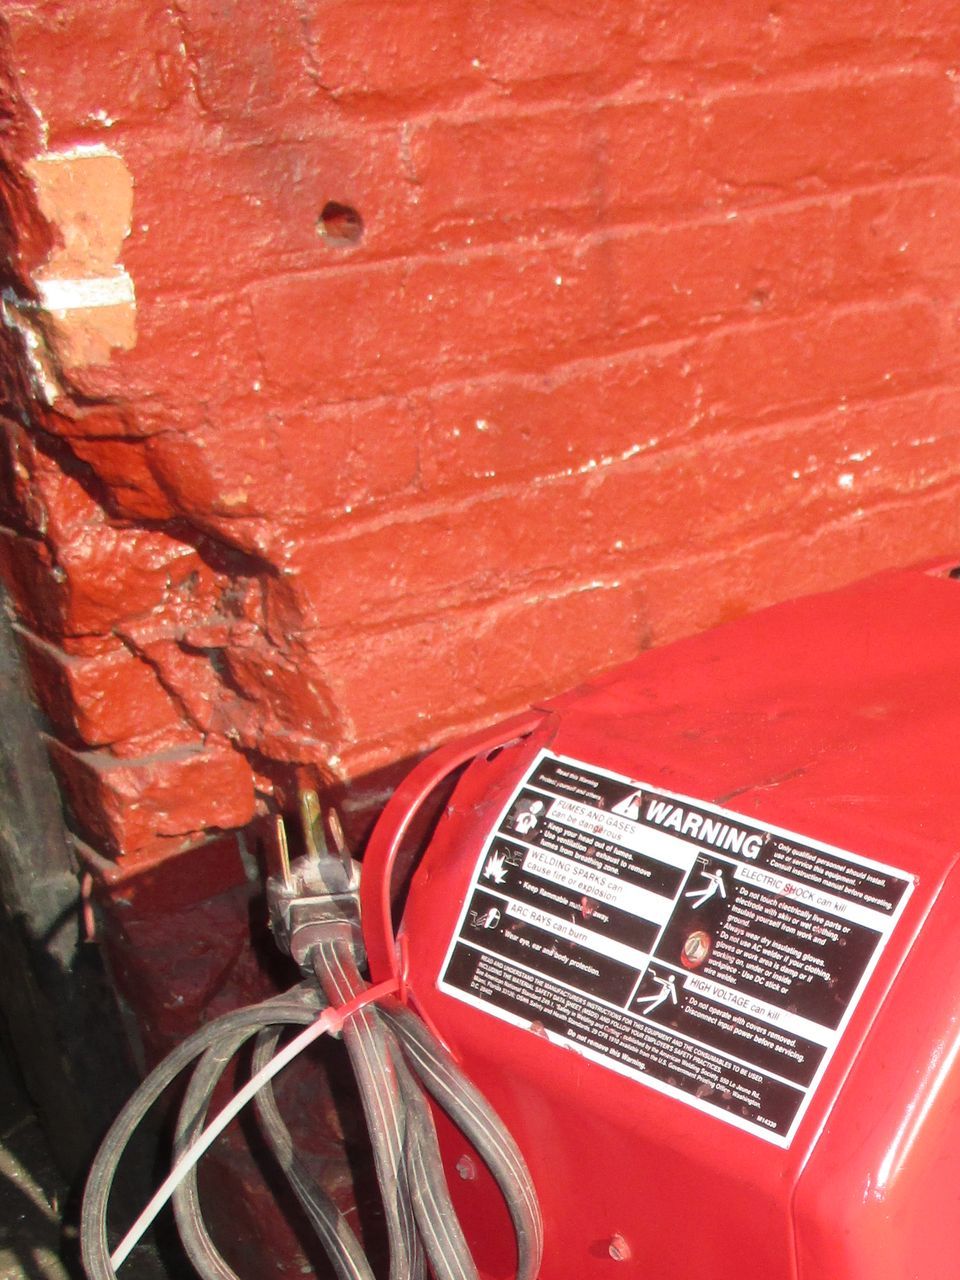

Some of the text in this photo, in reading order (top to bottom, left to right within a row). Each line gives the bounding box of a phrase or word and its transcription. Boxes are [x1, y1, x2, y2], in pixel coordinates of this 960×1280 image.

[546, 822, 564, 834] Keep
[562, 829, 578, 839] your
[580, 835, 594, 845] head
[550, 809, 622, 841] can be dangerous
[556, 800, 636, 834] FUMES AND GASES
[644, 800, 764, 860] WARNING
[530, 850, 572, 872] WELDING
[572, 866, 606, 886] SPARKS
[607, 882, 623, 892] can
[540, 838, 558, 851] fumes
[558, 846, 574, 856] from
[574, 852, 603, 869] breathing
[556, 836, 587, 852] ventilation
[594, 850, 620, 865] exhaust
[627, 863, 652, 877] remove
[777, 842, 867, 880] Only qualified personnel should
[792, 858, 856, 886] service equipment.
[522, 881, 539, 894] Keep
[526, 861, 617, 902] cause fire or explosion
[740, 868, 846, 912] ELECTRIC SHOCK can kill
[770, 859, 893, 910] Consult instruction manual before operating.
[510, 904, 588, 941] ARC RAYS can burn
[726, 914, 750, 928] ground.
[730, 904, 826, 946] Insulate yourself from work and
[734, 896, 764, 912] electrode
[764, 907, 778, 917] with
[777, 912, 792, 922] skin
[738, 887, 842, 931] Do not touch electrically parts
[504, 930, 600, 977] Wear body protection.
[714, 940, 799, 978] gloves work area damp
[722, 922, 826, 968] Always wear dry insulating gloves.
[728, 935, 804, 969] not use AC welder your
[708, 957, 780, 991] workpiece Use DC stick
[712, 949, 792, 985] working under inside
[716, 971, 738, 984] welder.
[690, 978, 780, 1020] HIGH VOLTAGE can kill
[684, 1005, 804, 1063] Disconnect input power before servicing.
[708, 1005, 796, 1048] operate with covers removed.
[586, 1038, 646, 1070] remove Warning.
